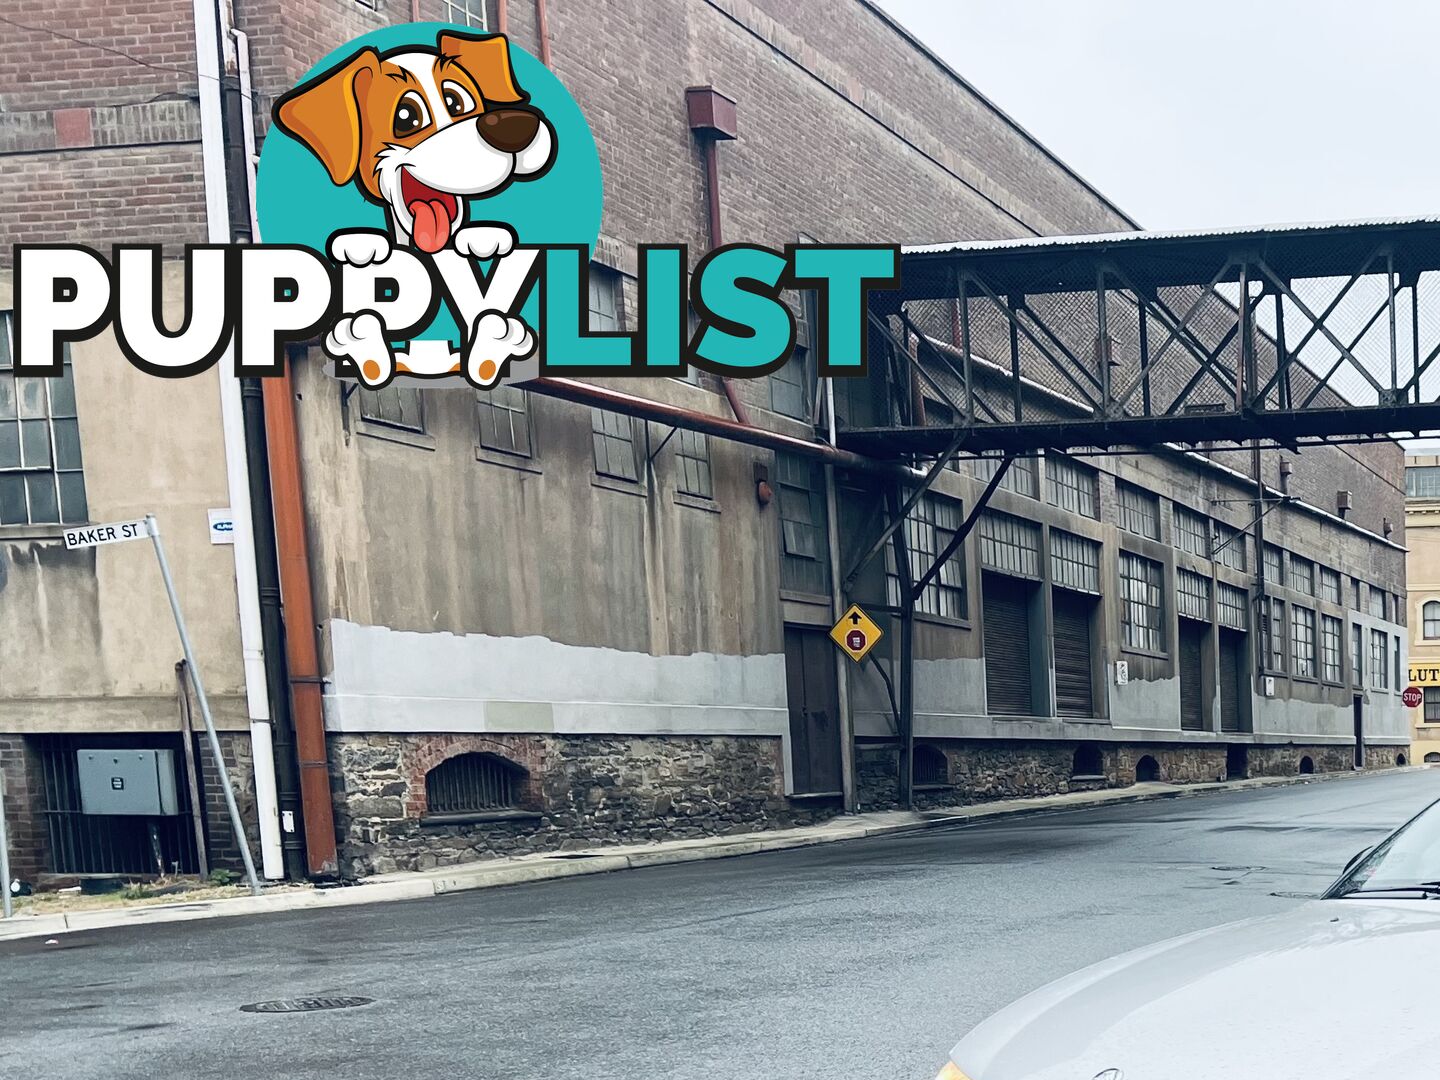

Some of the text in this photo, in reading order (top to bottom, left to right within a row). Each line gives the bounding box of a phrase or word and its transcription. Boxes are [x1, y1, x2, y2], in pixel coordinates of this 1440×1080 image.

[67, 523, 138, 547] BAKER ST
[1403, 692, 1422, 703] STOP
